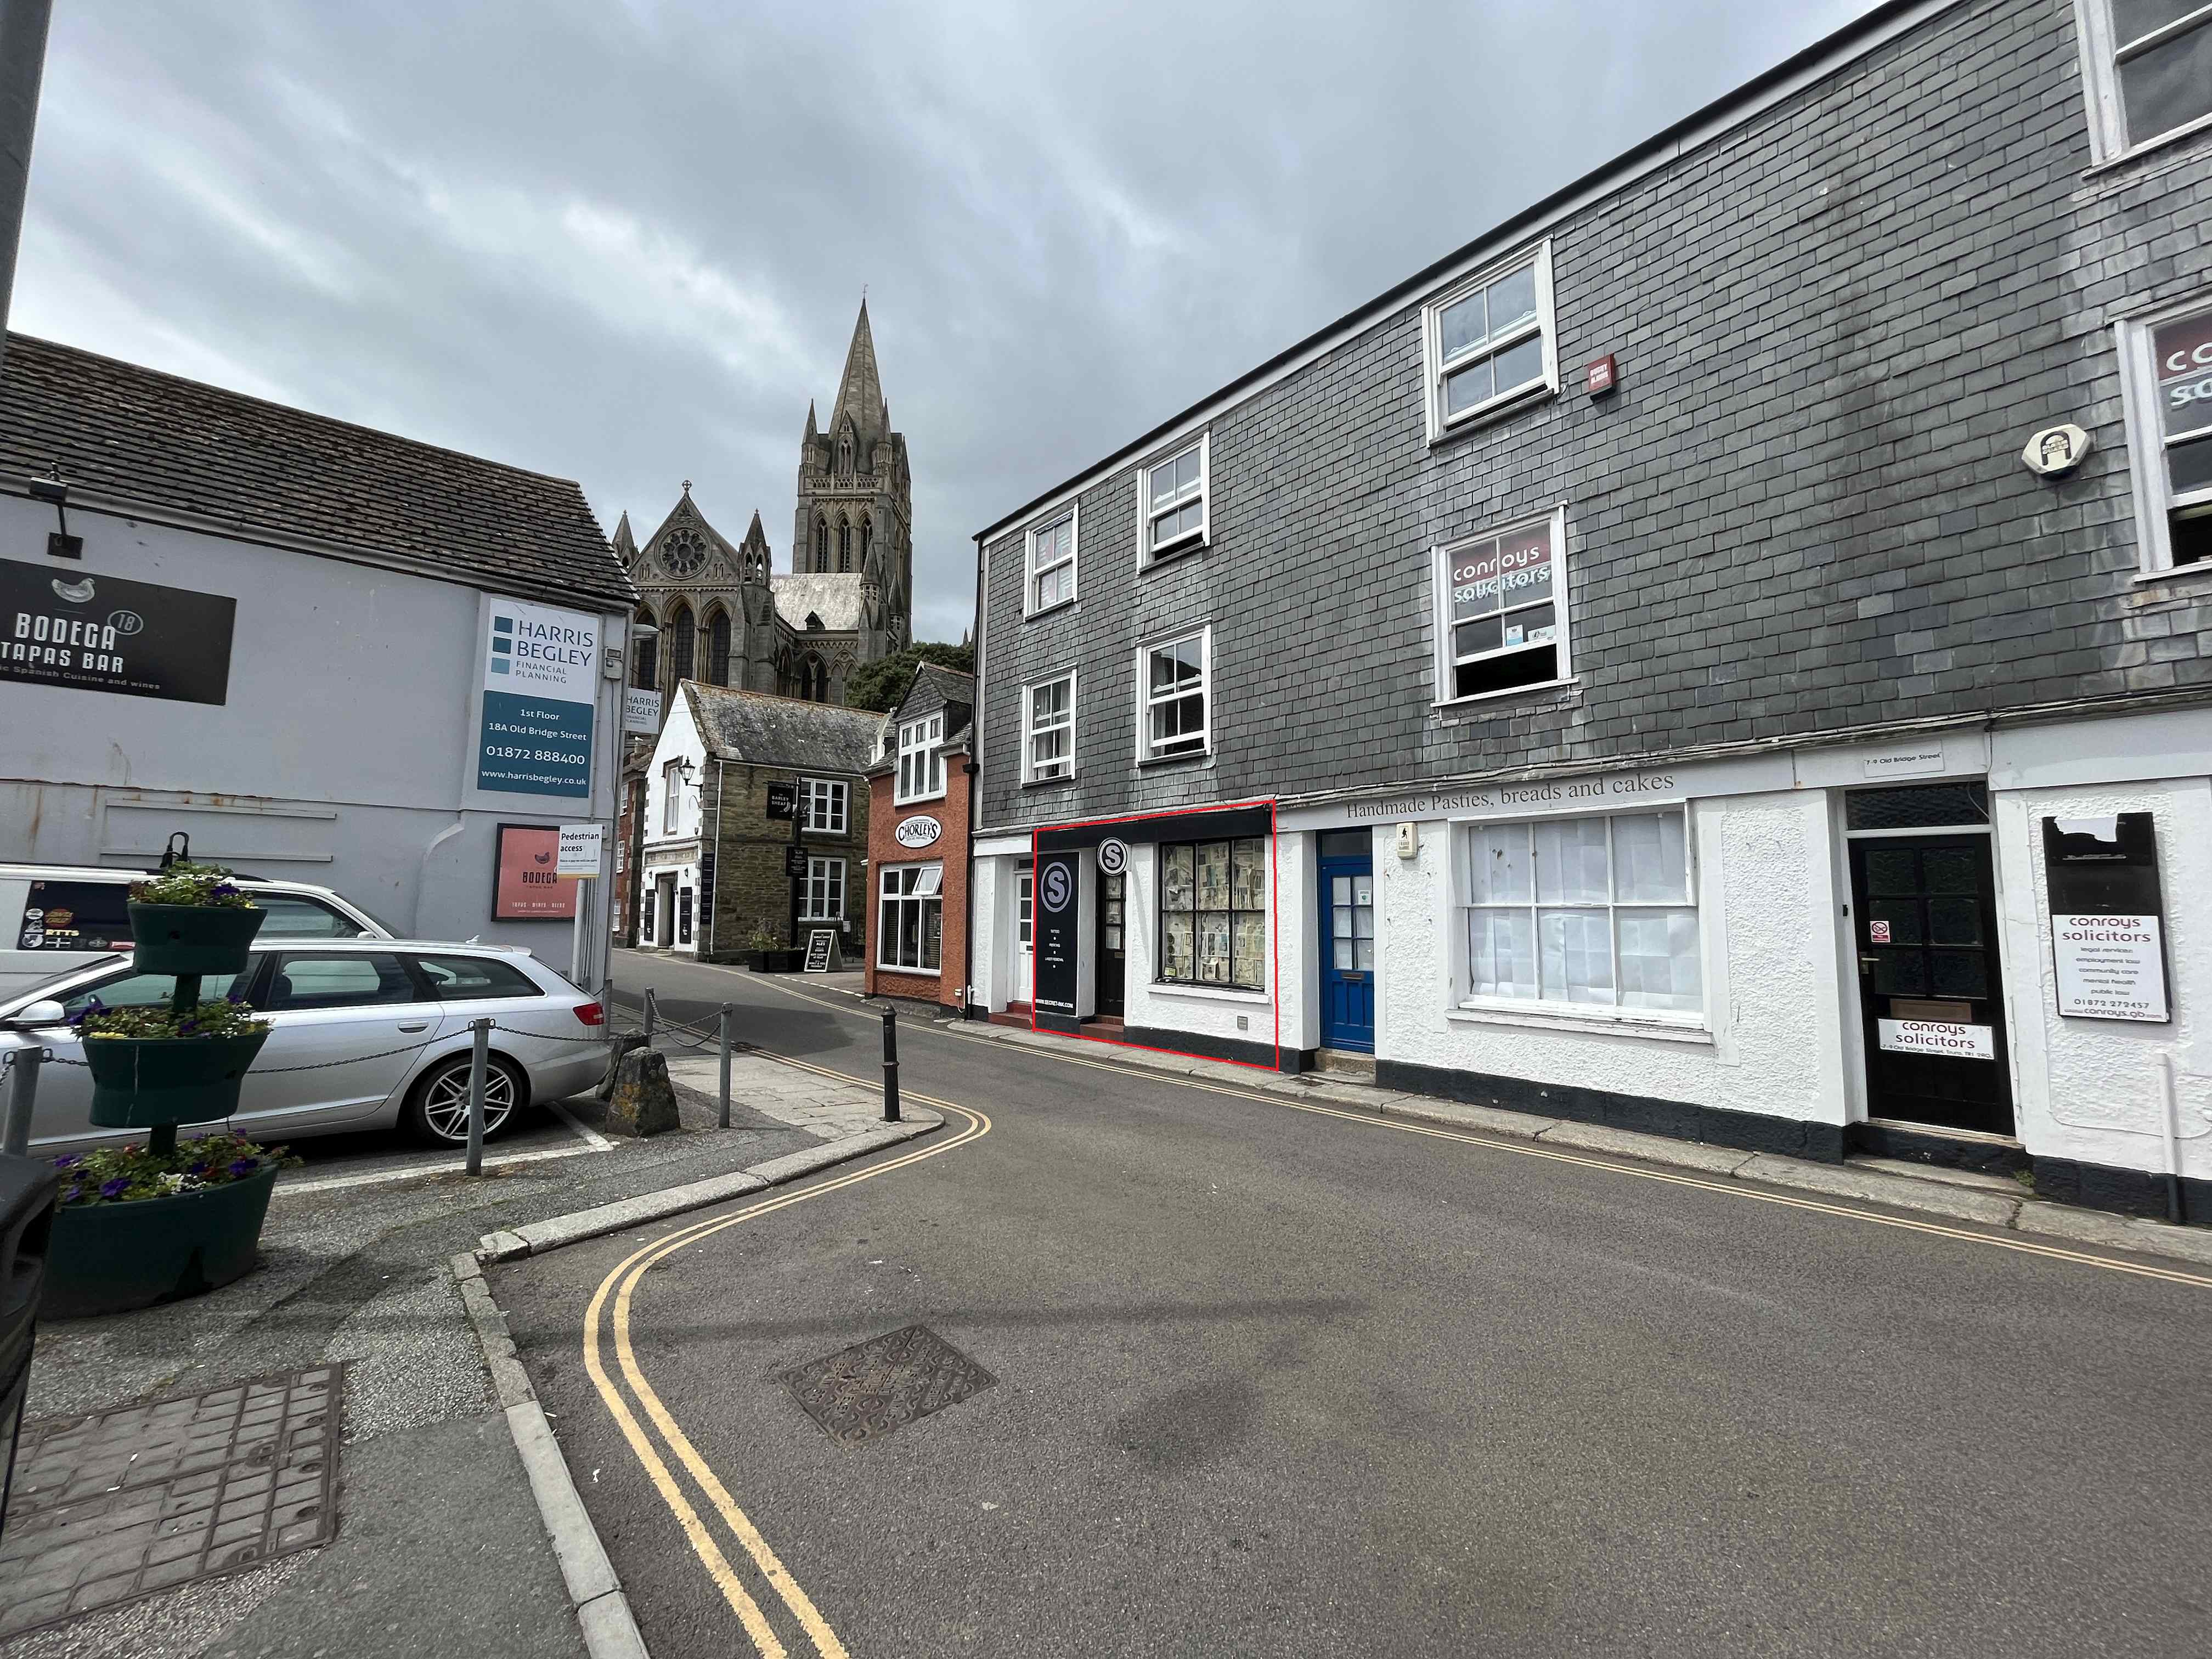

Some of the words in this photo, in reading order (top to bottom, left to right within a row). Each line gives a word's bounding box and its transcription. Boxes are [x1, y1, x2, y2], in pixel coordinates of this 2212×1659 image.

[1454, 546, 1540, 582] conroys
[117, 613, 136, 631] 18
[15, 612, 116, 651] BODEGA
[518, 620, 594, 647] HARRIS
[1, 641, 71, 667] TAPAS
[82, 652, 124, 673] BAR
[517, 640, 592, 667] BEGLEY
[516, 661, 567, 675] FINANCIAL
[516, 669, 567, 684] PLANNING
[13, 665, 59, 678] Spanish
[63, 672, 104, 684] Cuisine
[108, 678, 127, 686] and
[131, 681, 160, 690] wines
[626, 705, 659, 716] BEGLEY
[627, 696, 659, 708] HARRIS
[520, 709, 535, 718] 1st
[537, 710, 560, 720] Floor
[488, 723, 508, 732] 18A
[510, 725, 527, 734] Old
[528, 726, 558, 738] Bridge
[560, 730, 588, 741] Street
[486, 746, 531, 760] 01872
[534, 749, 585, 765] 888400
[481, 770, 587, 786] www.harrisbegley.co.uk
[1347, 797, 1426, 818] Handmade
[1431, 791, 1494, 811] Pasties,
[1500, 783, 1562, 804] breads
[1568, 777, 1605, 798] and
[1612, 772, 1674, 793] cakes
[561, 832, 599, 840] Pedestrian
[898, 822, 938, 841] CHORLEY'S
[1105, 845, 1121, 868] S
[522, 872, 557, 884] BODEGA
[1047, 871, 1065, 904] S
[2069, 918, 2141, 929] conroys
[2062, 929, 2151, 941] solicitors
[2074, 998, 2107, 1007] 01872
[1902, 1022, 1966, 1036] conroys
[1895, 1033, 1976, 1049] solicitors
